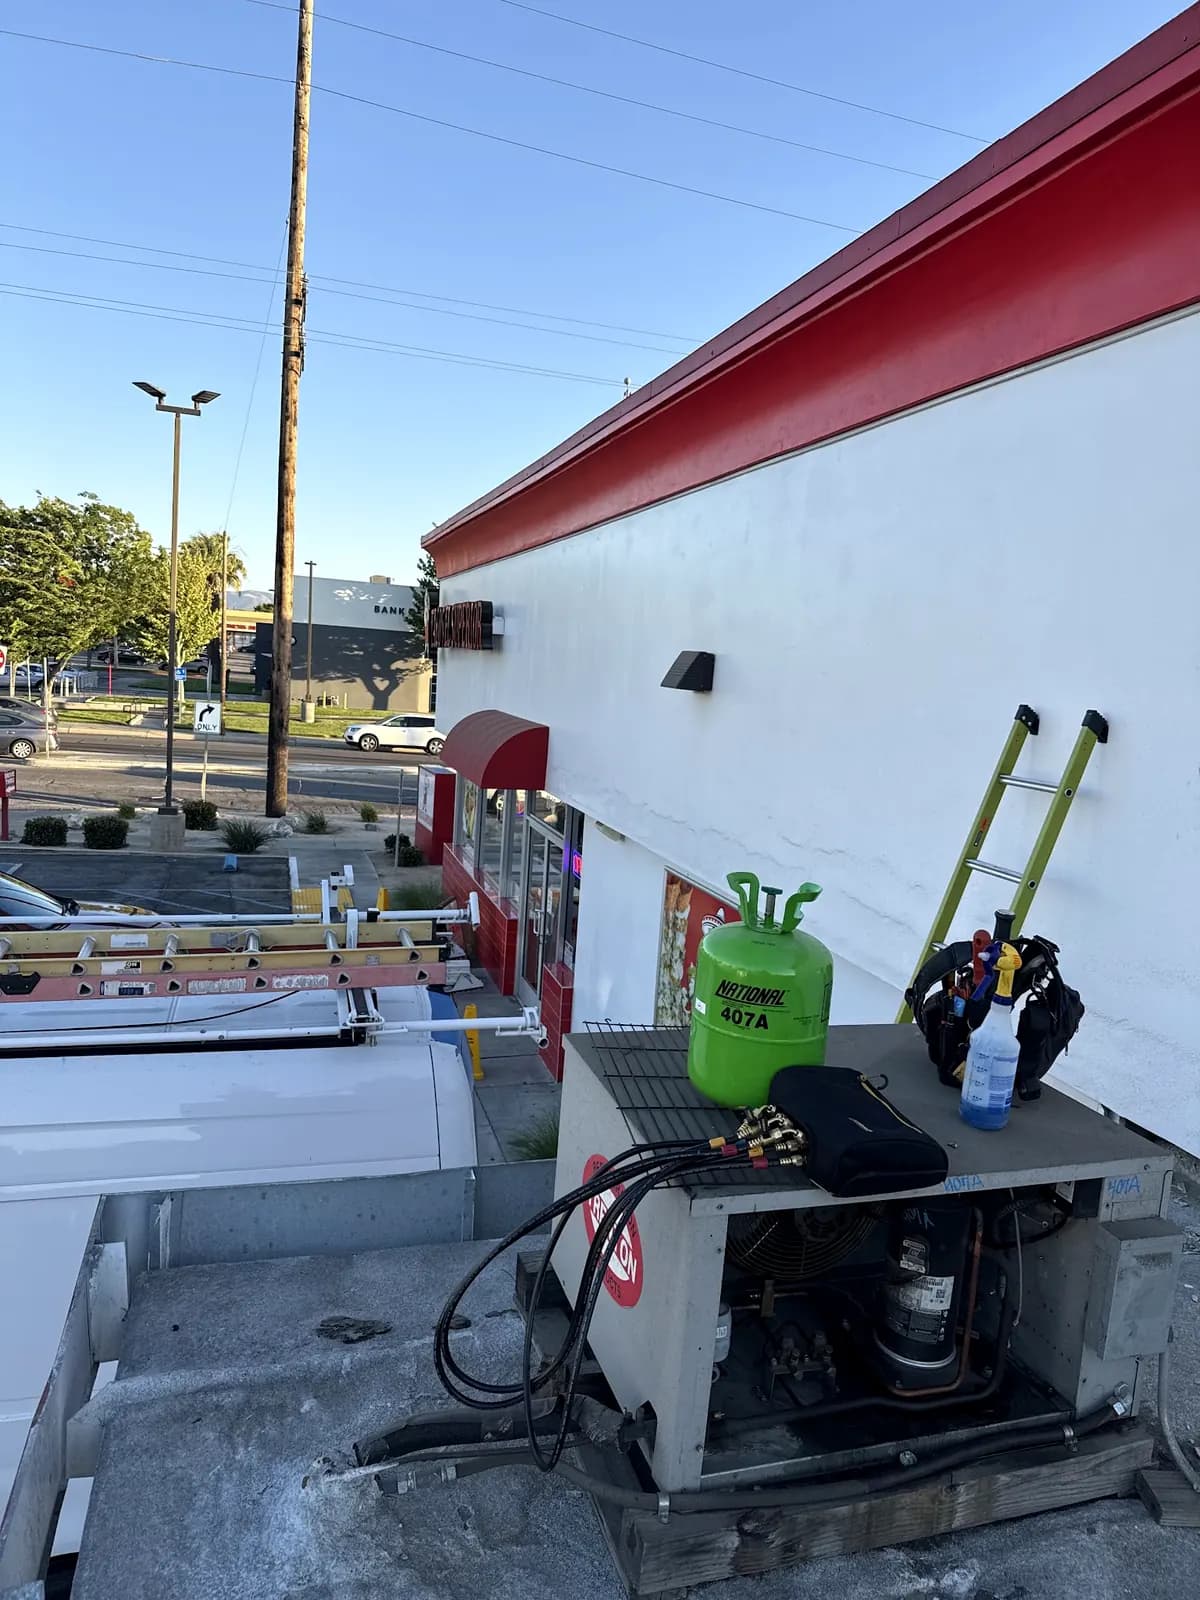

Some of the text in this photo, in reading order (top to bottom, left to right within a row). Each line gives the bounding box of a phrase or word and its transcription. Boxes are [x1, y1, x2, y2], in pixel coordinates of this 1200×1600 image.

[374, 605, 405, 616] BANK
[197, 723, 217, 731] ONLY
[716, 979, 785, 1005] NATIONAL
[720, 1006, 769, 1029] 407A
